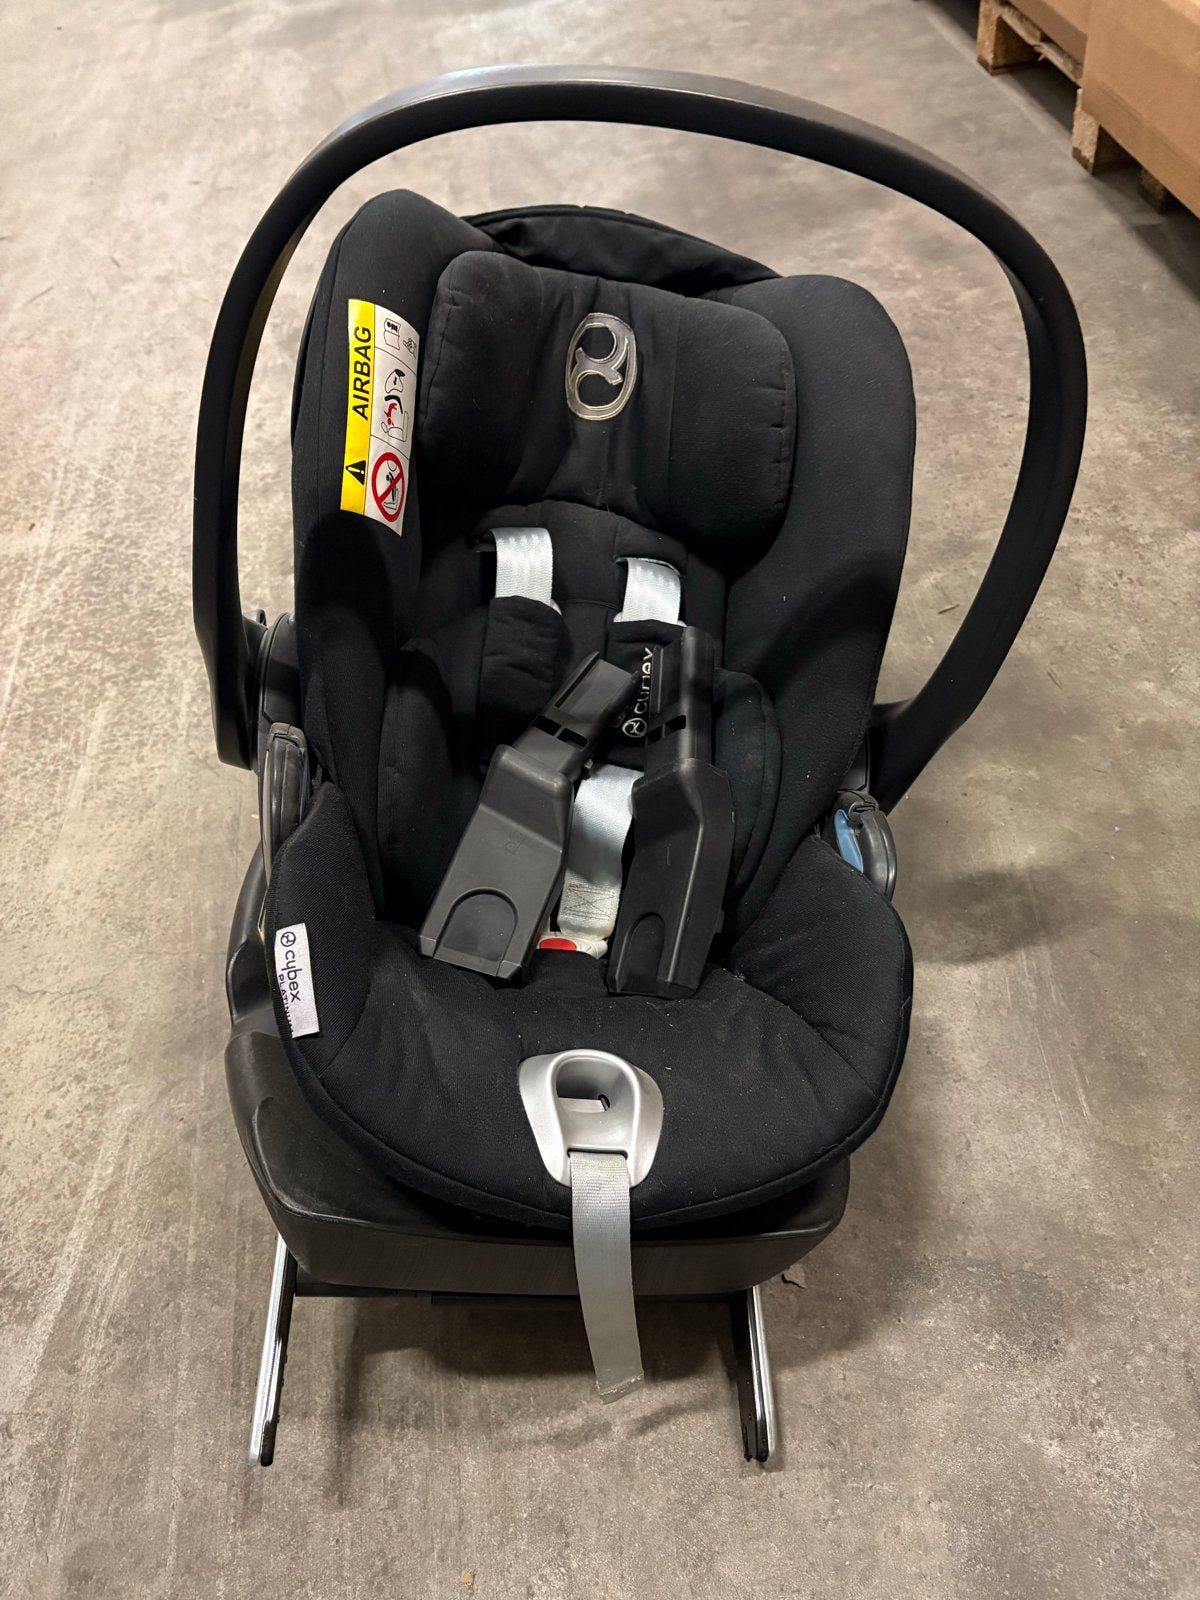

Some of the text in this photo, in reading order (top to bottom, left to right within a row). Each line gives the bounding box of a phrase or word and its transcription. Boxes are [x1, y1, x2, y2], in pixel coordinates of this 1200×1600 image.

[352, 326, 372, 421] AIRBAG
[278, 973, 294, 1033] PLATIN
[281, 950, 303, 1003] cybex
